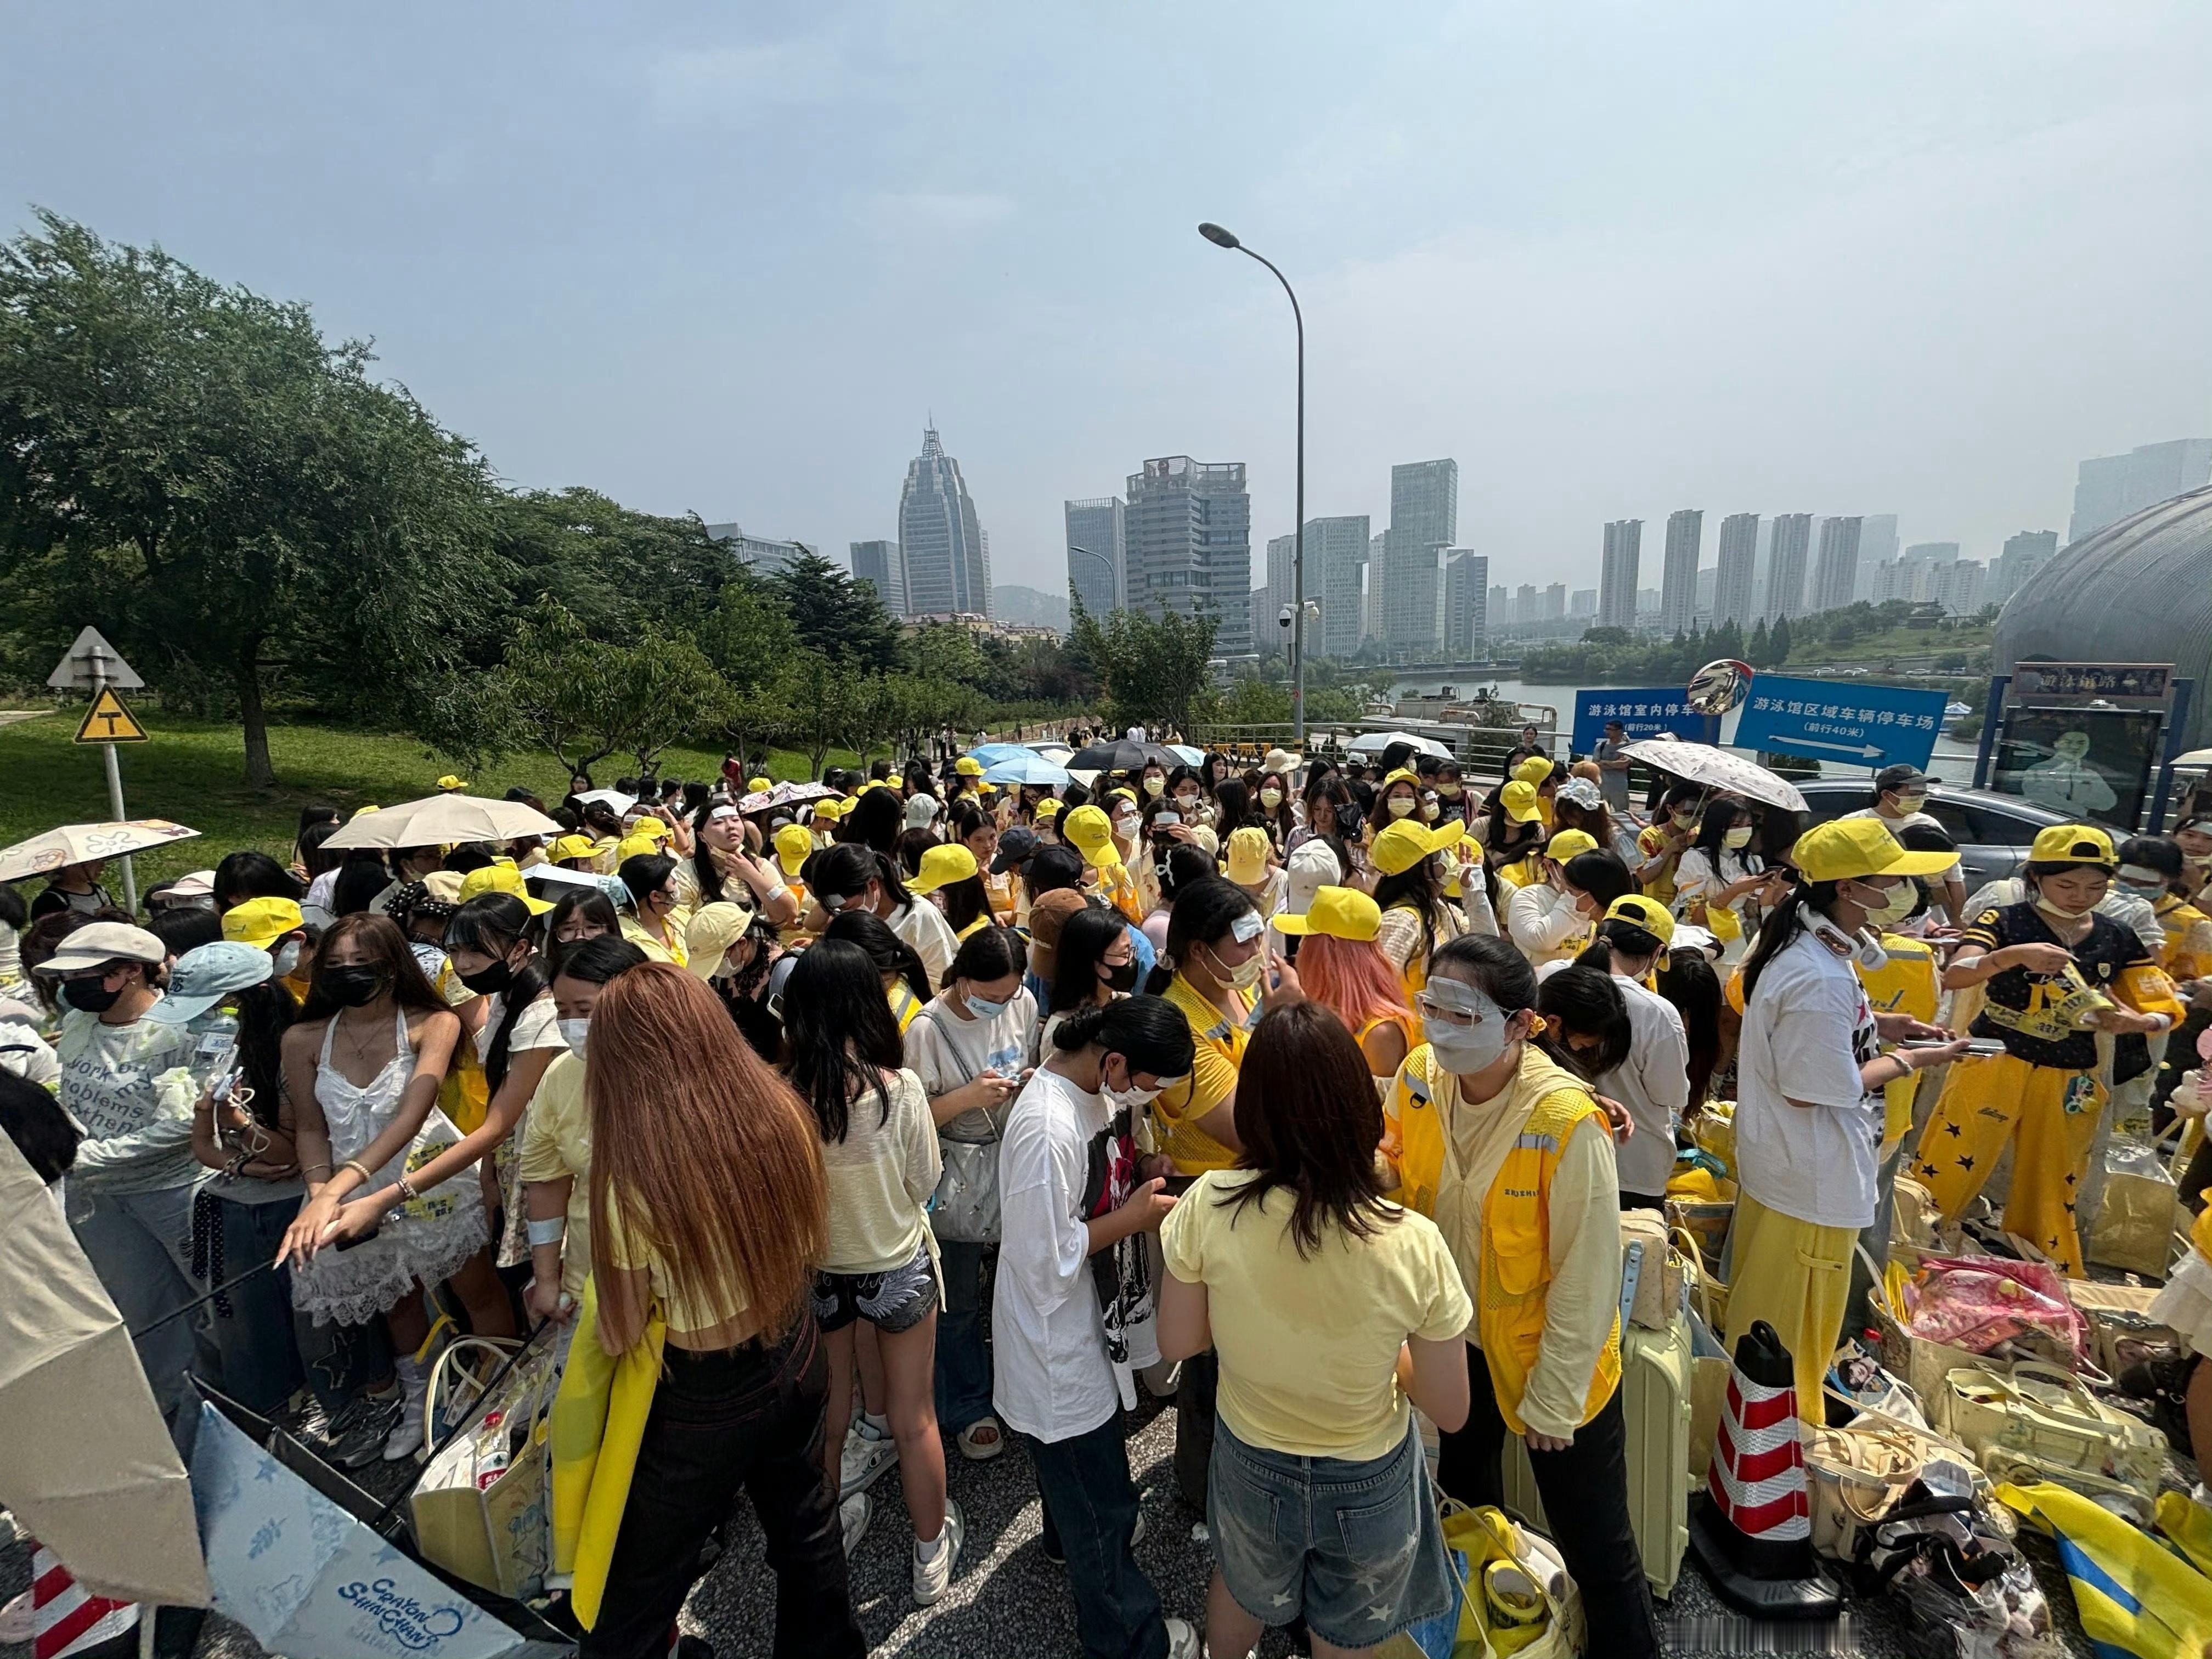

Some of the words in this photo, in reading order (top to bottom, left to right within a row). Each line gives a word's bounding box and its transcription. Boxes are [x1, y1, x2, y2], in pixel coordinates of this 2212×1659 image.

[1588, 704, 1695, 716] 游泳馆室内停车
[1753, 697, 1934, 730] 游泳馆区域车辆停车场
[61, 1077, 144, 1118] roblems
[115, 1073, 153, 1098] my
[372, 1578, 431, 1622] CRAYON
